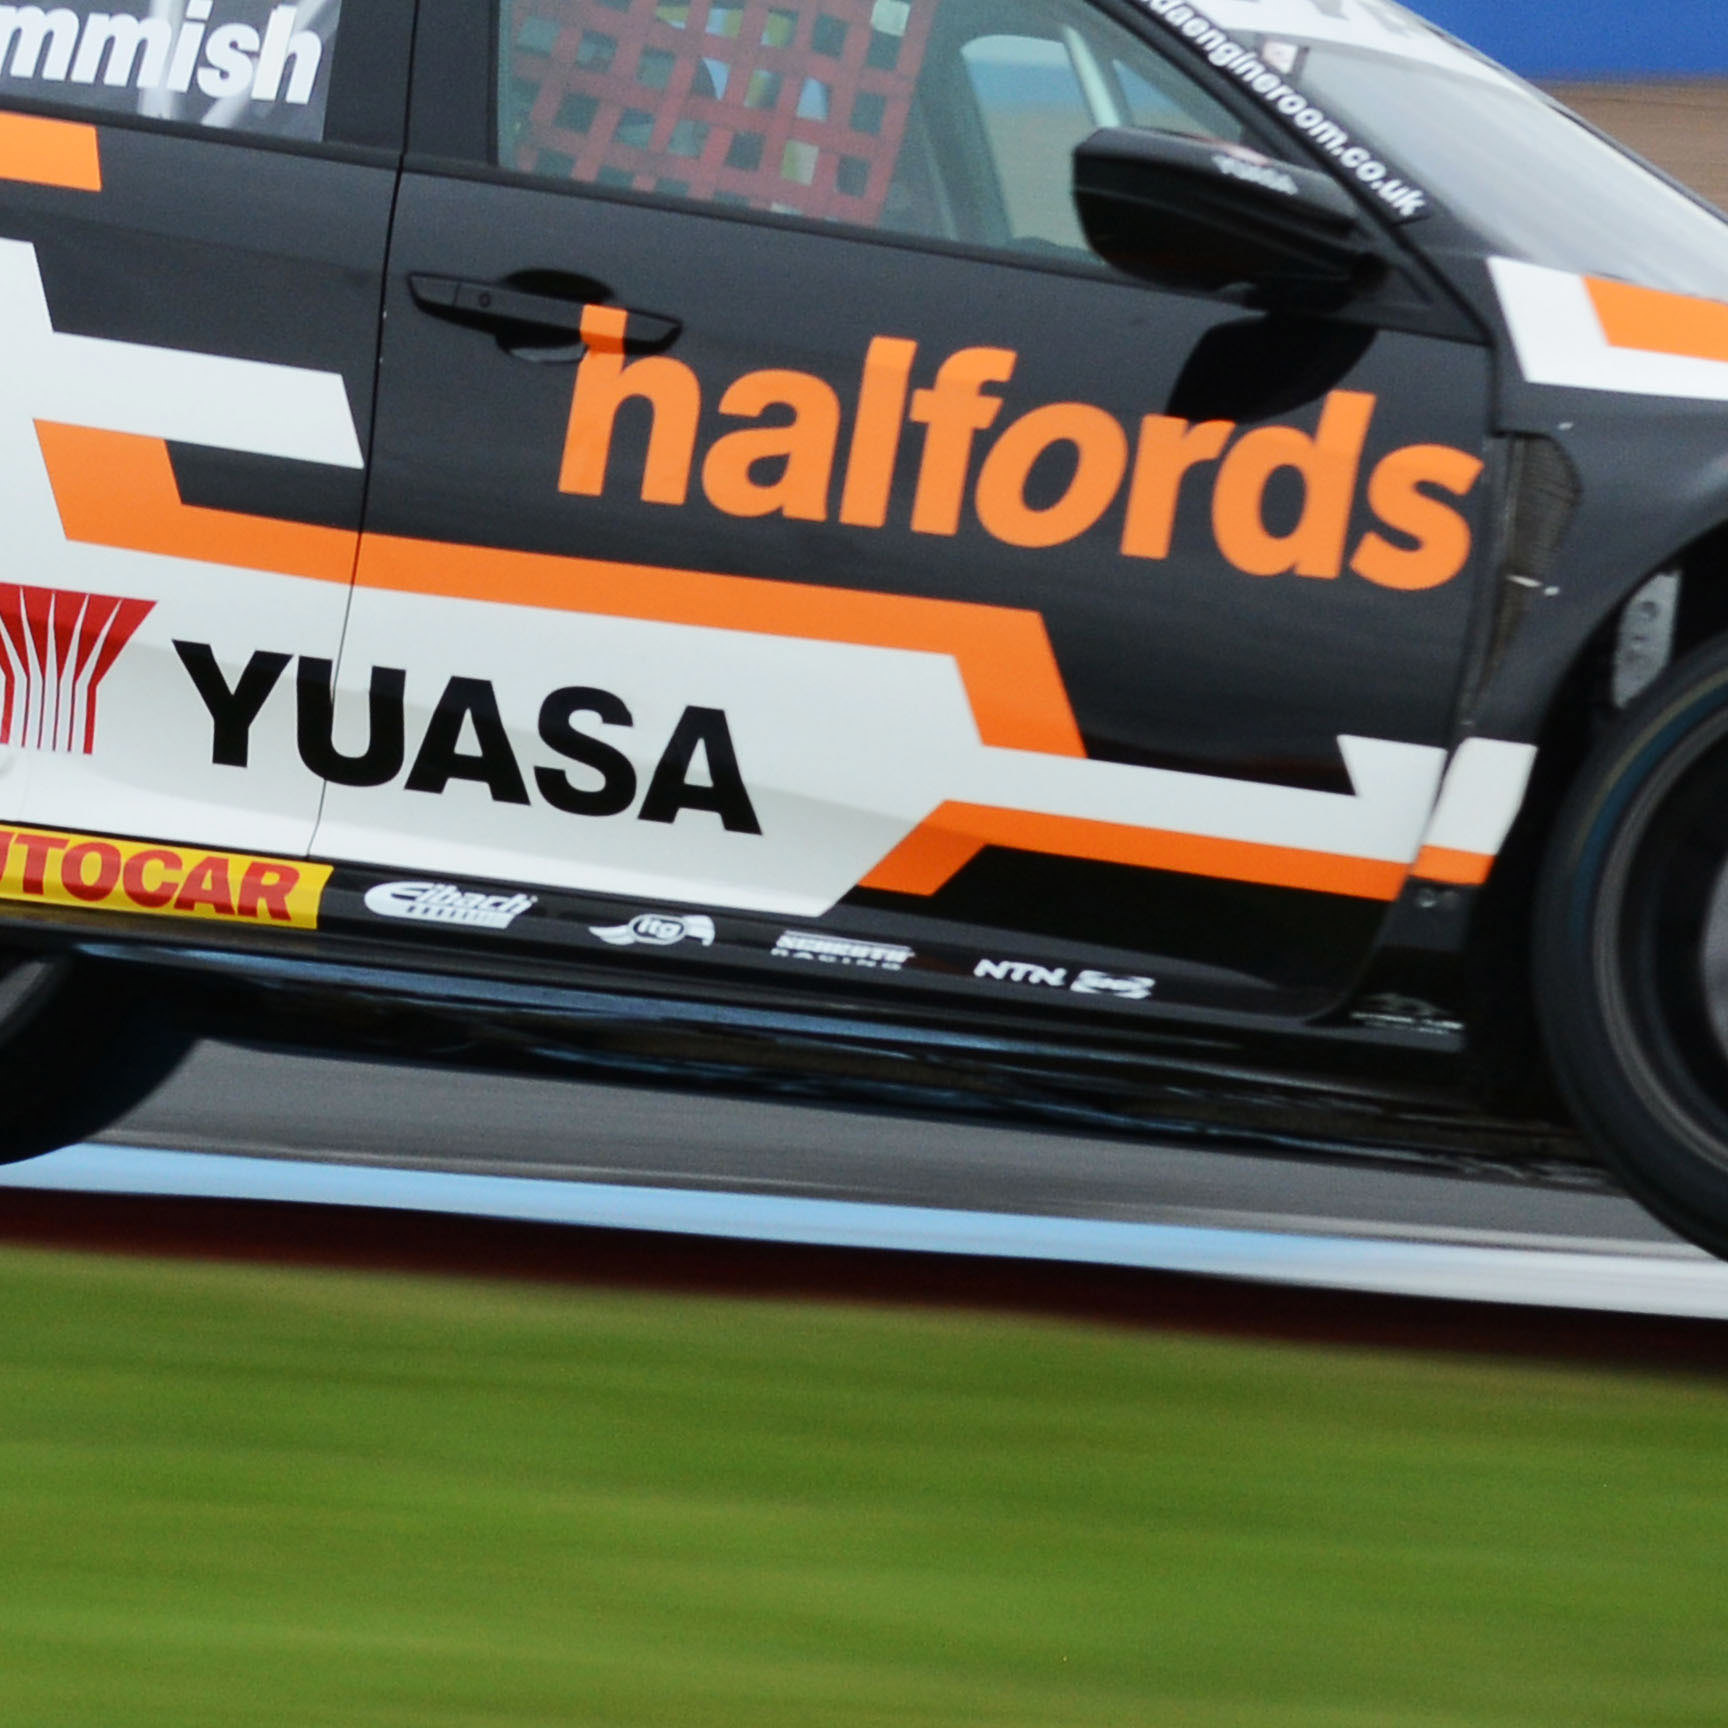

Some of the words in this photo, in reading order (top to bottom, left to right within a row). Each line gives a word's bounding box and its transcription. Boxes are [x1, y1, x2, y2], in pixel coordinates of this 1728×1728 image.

[557, 303, 1483, 591] halfords
[173, 640, 761, 835] YUASA
[973, 958, 1067, 987] NTN
